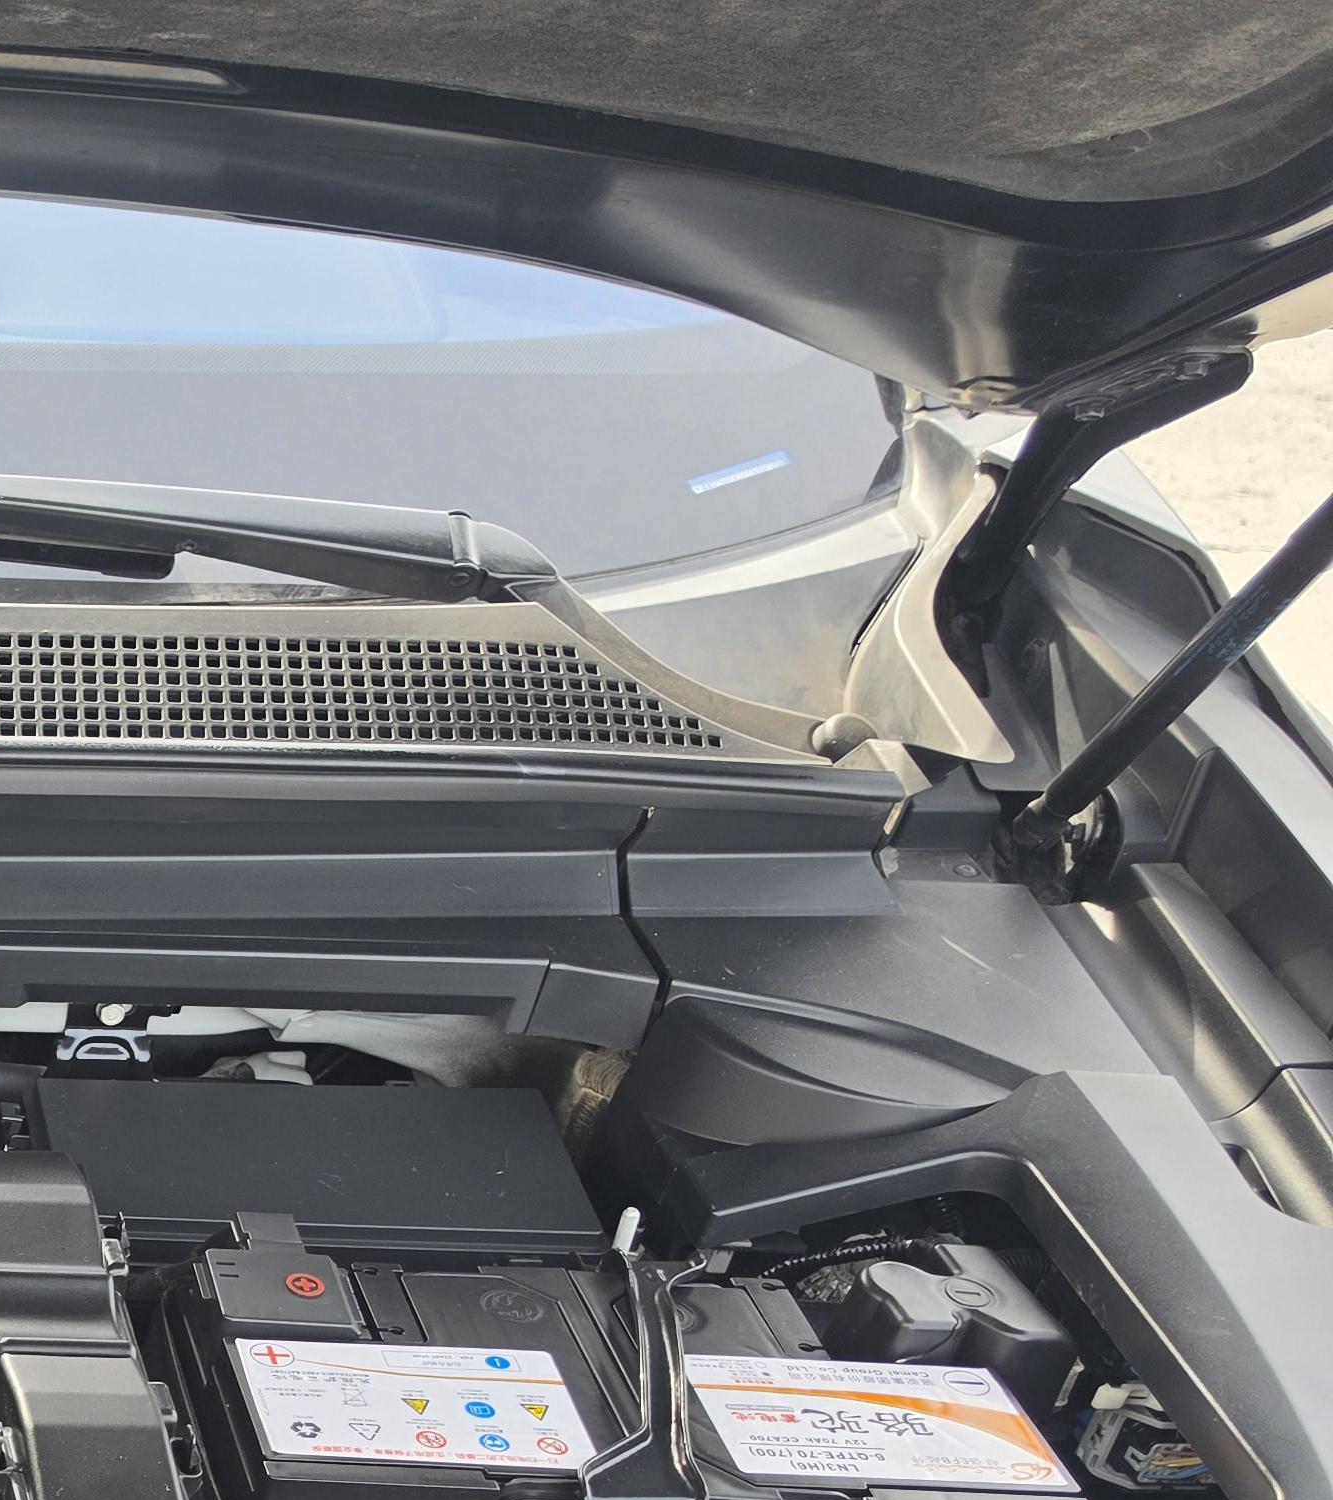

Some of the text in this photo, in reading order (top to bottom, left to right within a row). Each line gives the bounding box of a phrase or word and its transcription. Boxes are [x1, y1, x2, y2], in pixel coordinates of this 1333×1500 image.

[801, 1408, 934, 1436] 骆驼
[749, 1434, 799, 1442] CCA700
[804, 1437, 838, 1445] 70Ah
[749, 1446, 886, 1461] 6-QTPE-70 (700)
[791, 1460, 861, 1473] LN3(H6)
